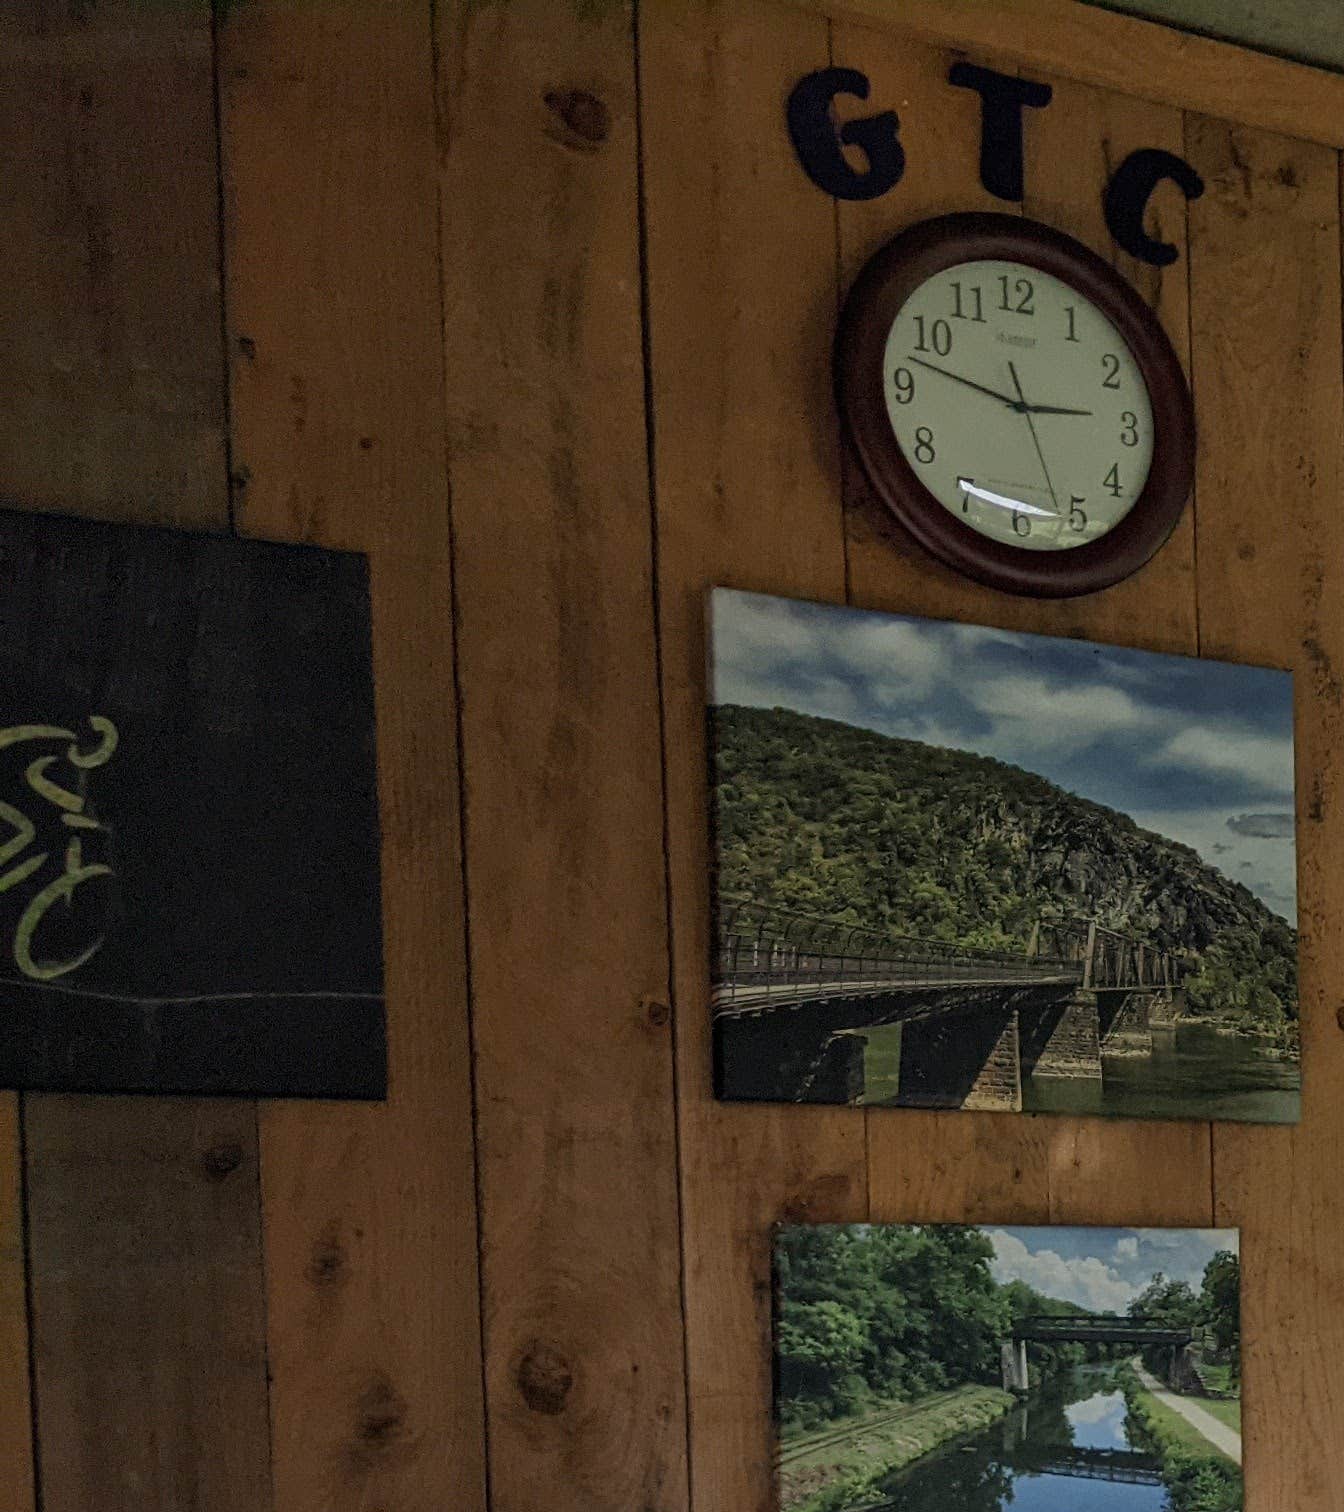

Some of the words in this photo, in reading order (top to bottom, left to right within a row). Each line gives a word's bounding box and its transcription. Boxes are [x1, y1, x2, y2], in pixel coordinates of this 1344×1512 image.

[950, 282, 987, 324] 11
[997, 275, 1035, 316] 12
[912, 315, 953, 357] 10
[1062, 305, 1080, 343] 1
[893, 367, 916, 405] 9
[1102, 353, 1121, 390] 2
[914, 426, 936, 464] 8
[1119, 411, 1140, 447] 3
[956, 476, 975, 513] 7
[1102, 462, 1124, 498] 4
[1011, 504, 1032, 537] 6
[1068, 496, 1088, 532] 5
